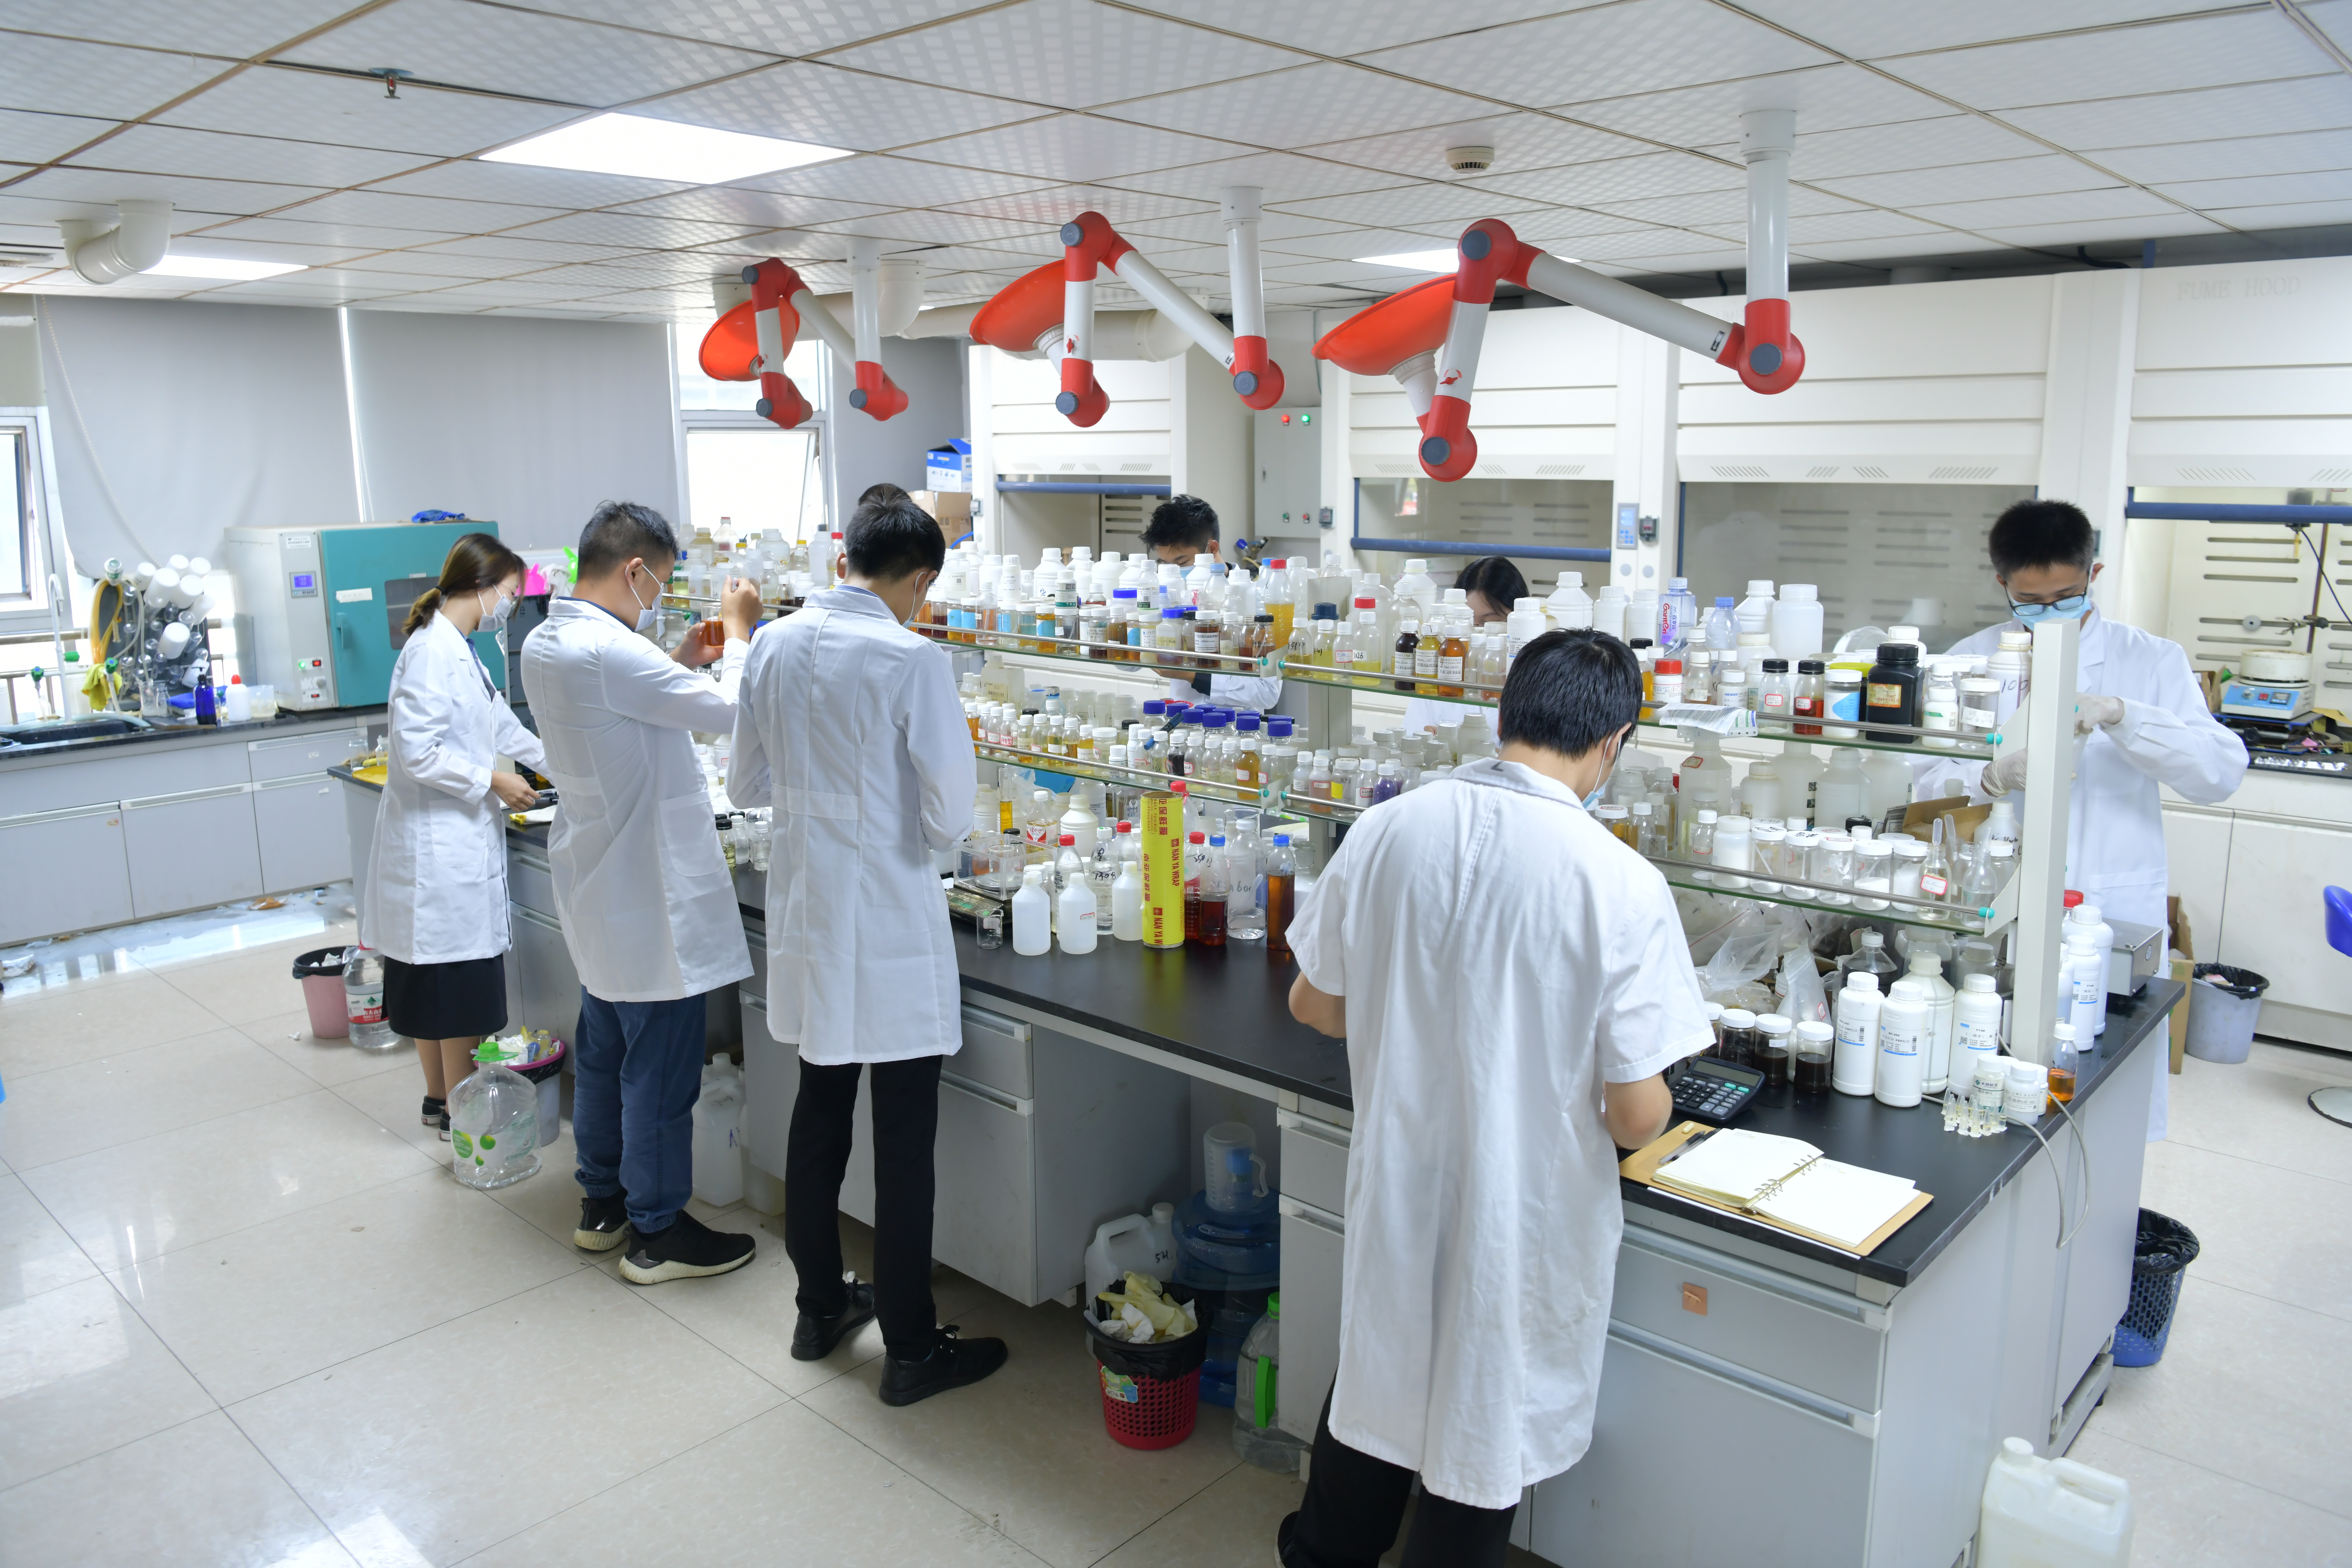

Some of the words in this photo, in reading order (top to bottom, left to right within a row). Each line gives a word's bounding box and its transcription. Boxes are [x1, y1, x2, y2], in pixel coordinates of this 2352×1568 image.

[2178, 280, 2230, 300] FUME
[2245, 277, 2300, 297] HOOD
[1172, 861, 1179, 870] YA
[1154, 917, 1163, 929] NAN
